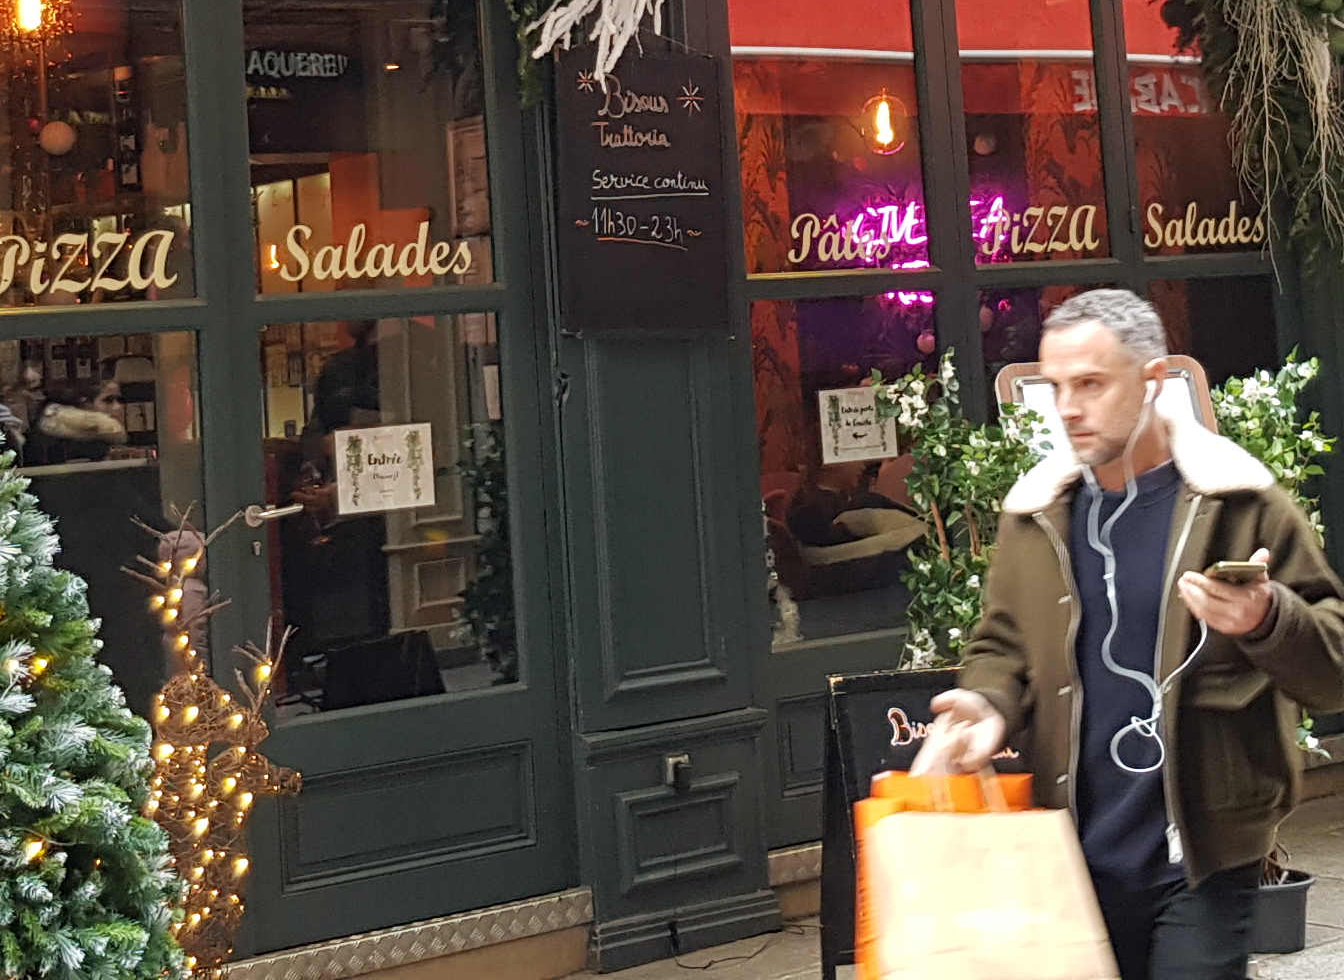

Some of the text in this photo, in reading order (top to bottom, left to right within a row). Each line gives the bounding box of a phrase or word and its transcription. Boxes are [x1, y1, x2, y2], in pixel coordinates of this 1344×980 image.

[597, 73, 670, 119] Bisous
[591, 121, 671, 148] Trattoria
[592, 169, 709, 191] Service continu
[787, 212, 892, 264] Pâtes
[1143, 200, 1265, 249] Salades
[279, 220, 473, 282] Salades
[367, 452, 404, 466] Entrée
